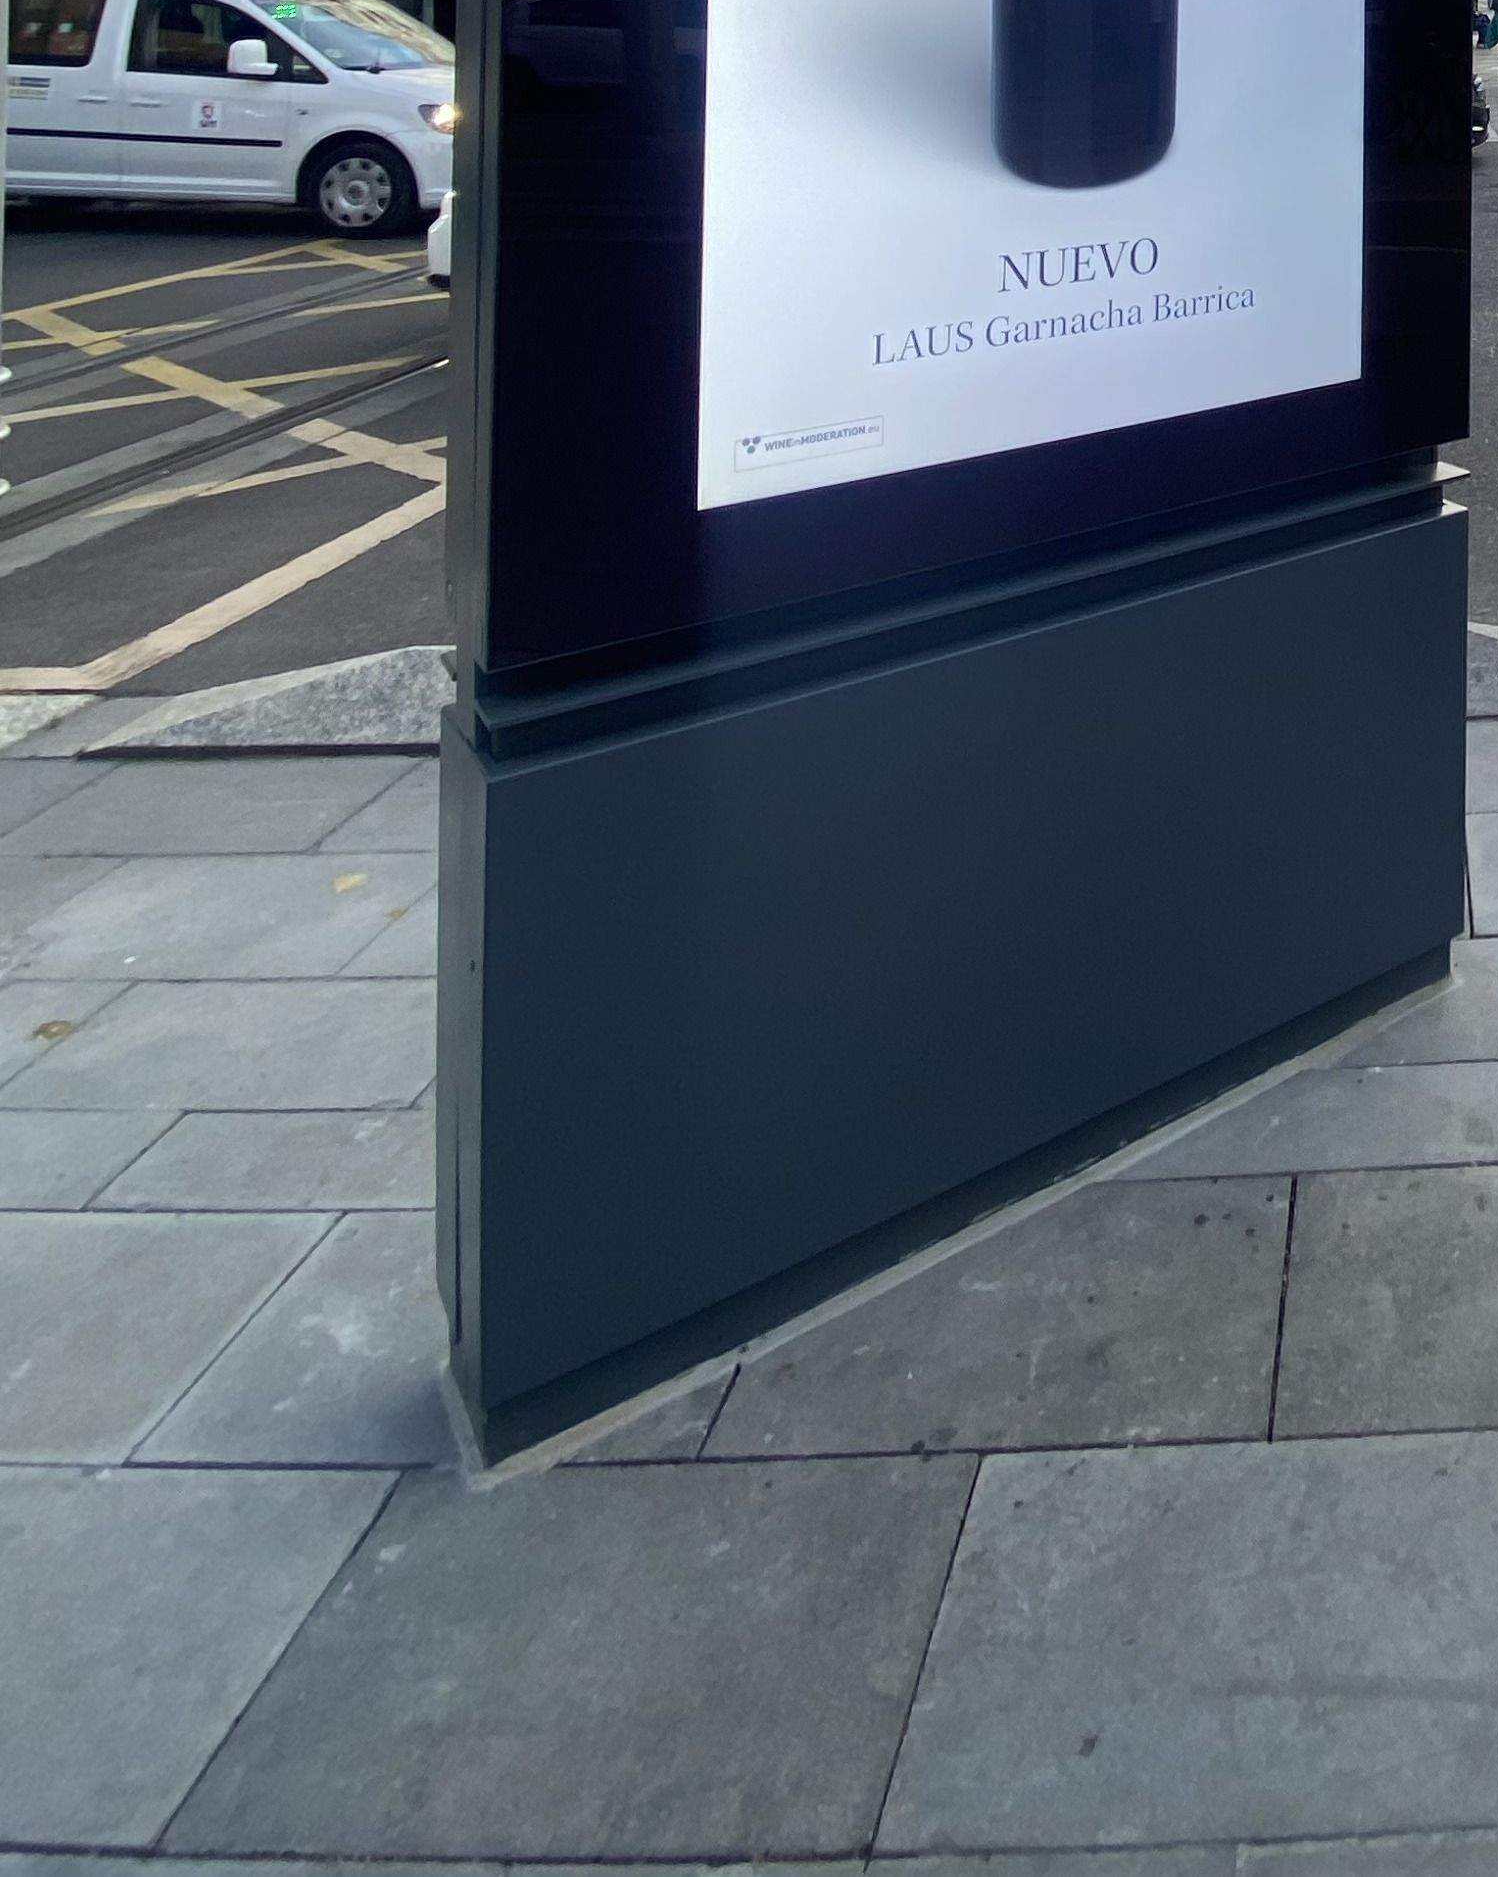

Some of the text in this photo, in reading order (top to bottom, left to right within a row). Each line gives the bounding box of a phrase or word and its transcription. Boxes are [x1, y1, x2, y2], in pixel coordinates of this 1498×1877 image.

[998, 237, 1159, 293] NUEVO
[872, 285, 1255, 366] LAUS Garnacha Barrica
